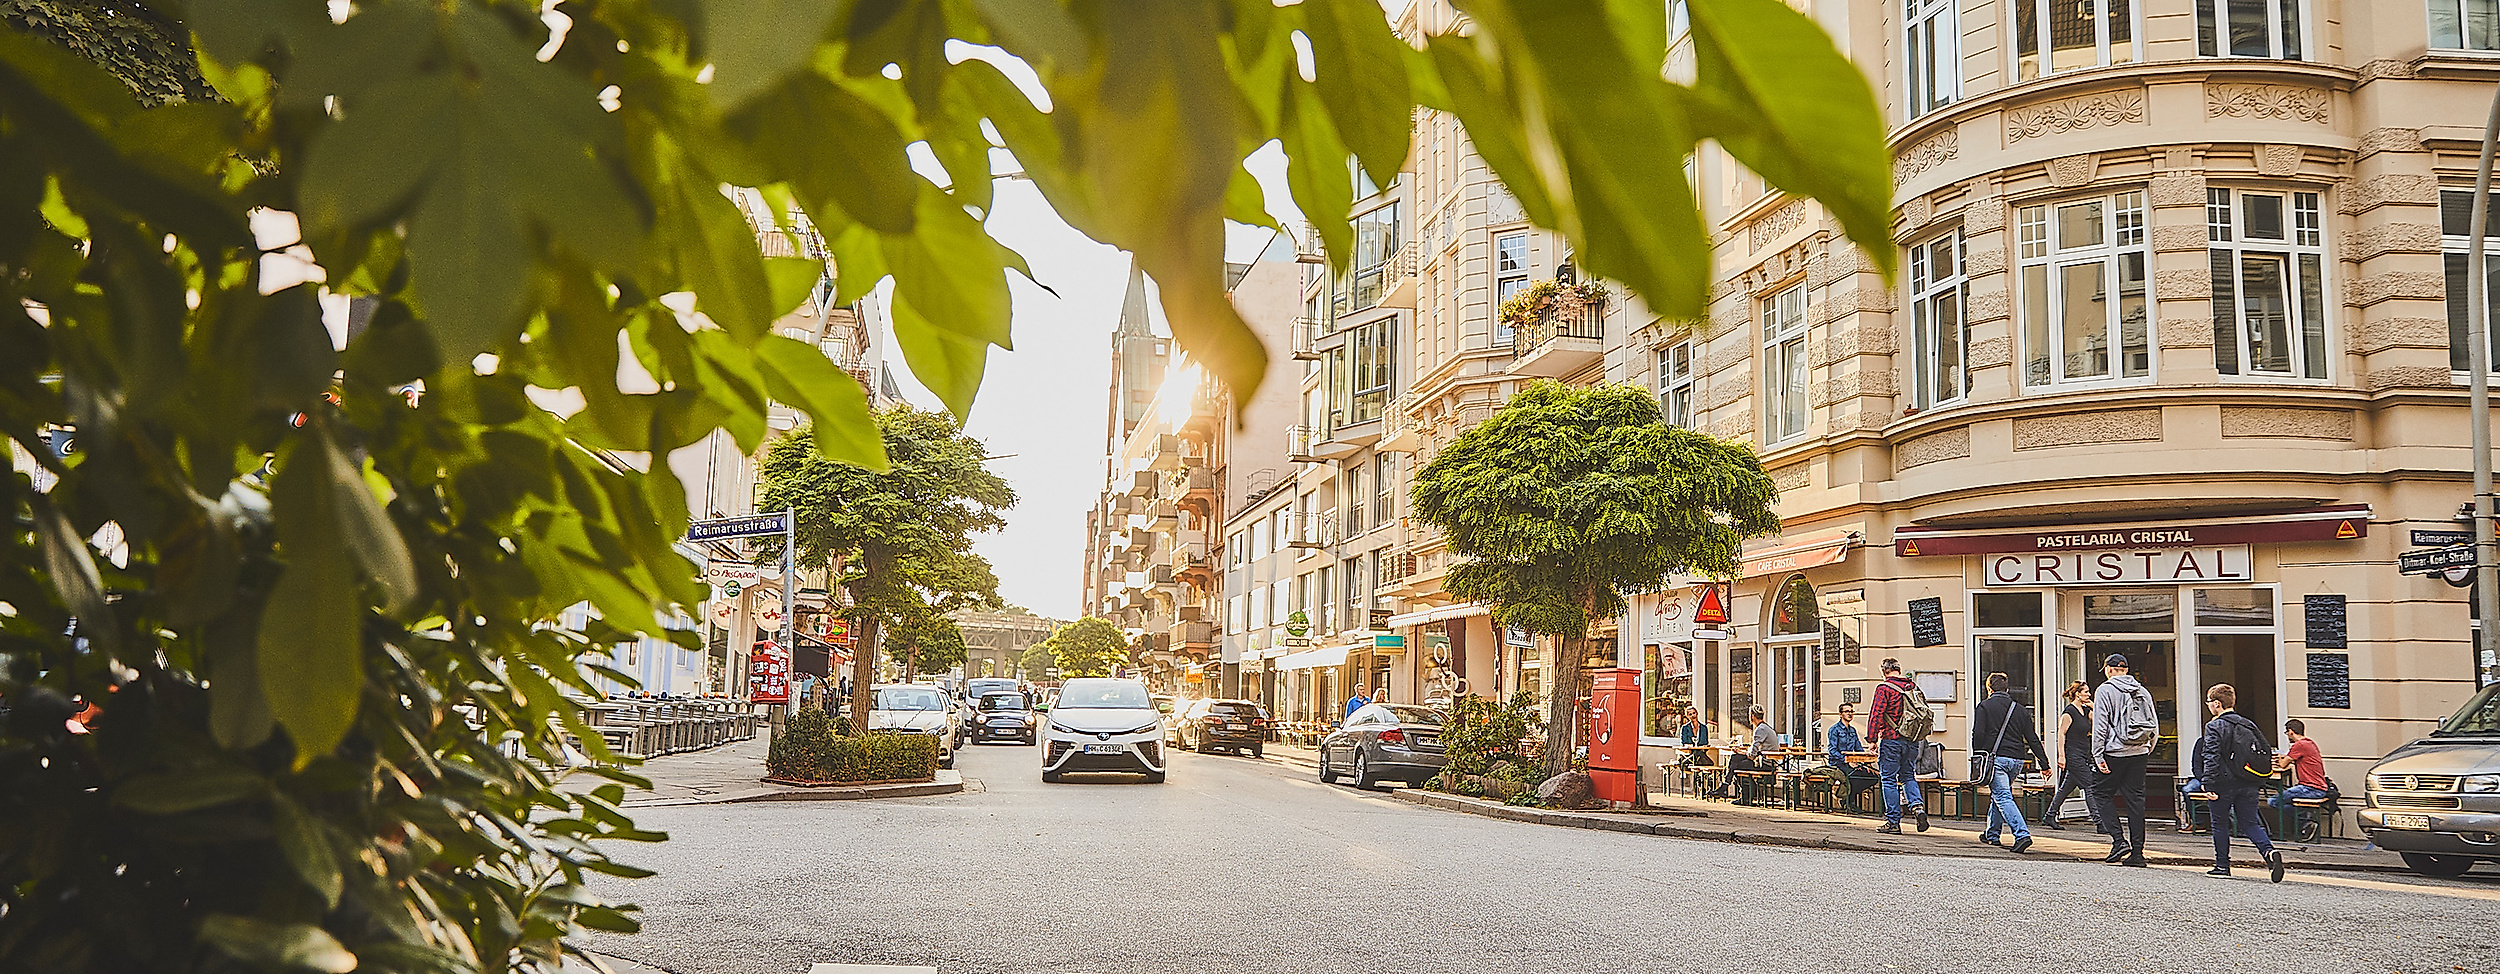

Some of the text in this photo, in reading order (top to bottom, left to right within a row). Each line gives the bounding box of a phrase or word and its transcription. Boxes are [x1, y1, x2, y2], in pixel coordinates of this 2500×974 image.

[694, 519, 778, 536] Reimarusstraße
[2036, 530, 2194, 548] PASTELARIA CRISTAL
[1757, 556, 1796, 572] CAFÉ CRISTAL
[1994, 549, 2241, 583] CRISTAL
[2403, 551, 2474, 568] Ditmar-Koel-Straße
[1702, 608, 1721, 617] DELTA
[1650, 622, 1684, 636] ZEITEN
